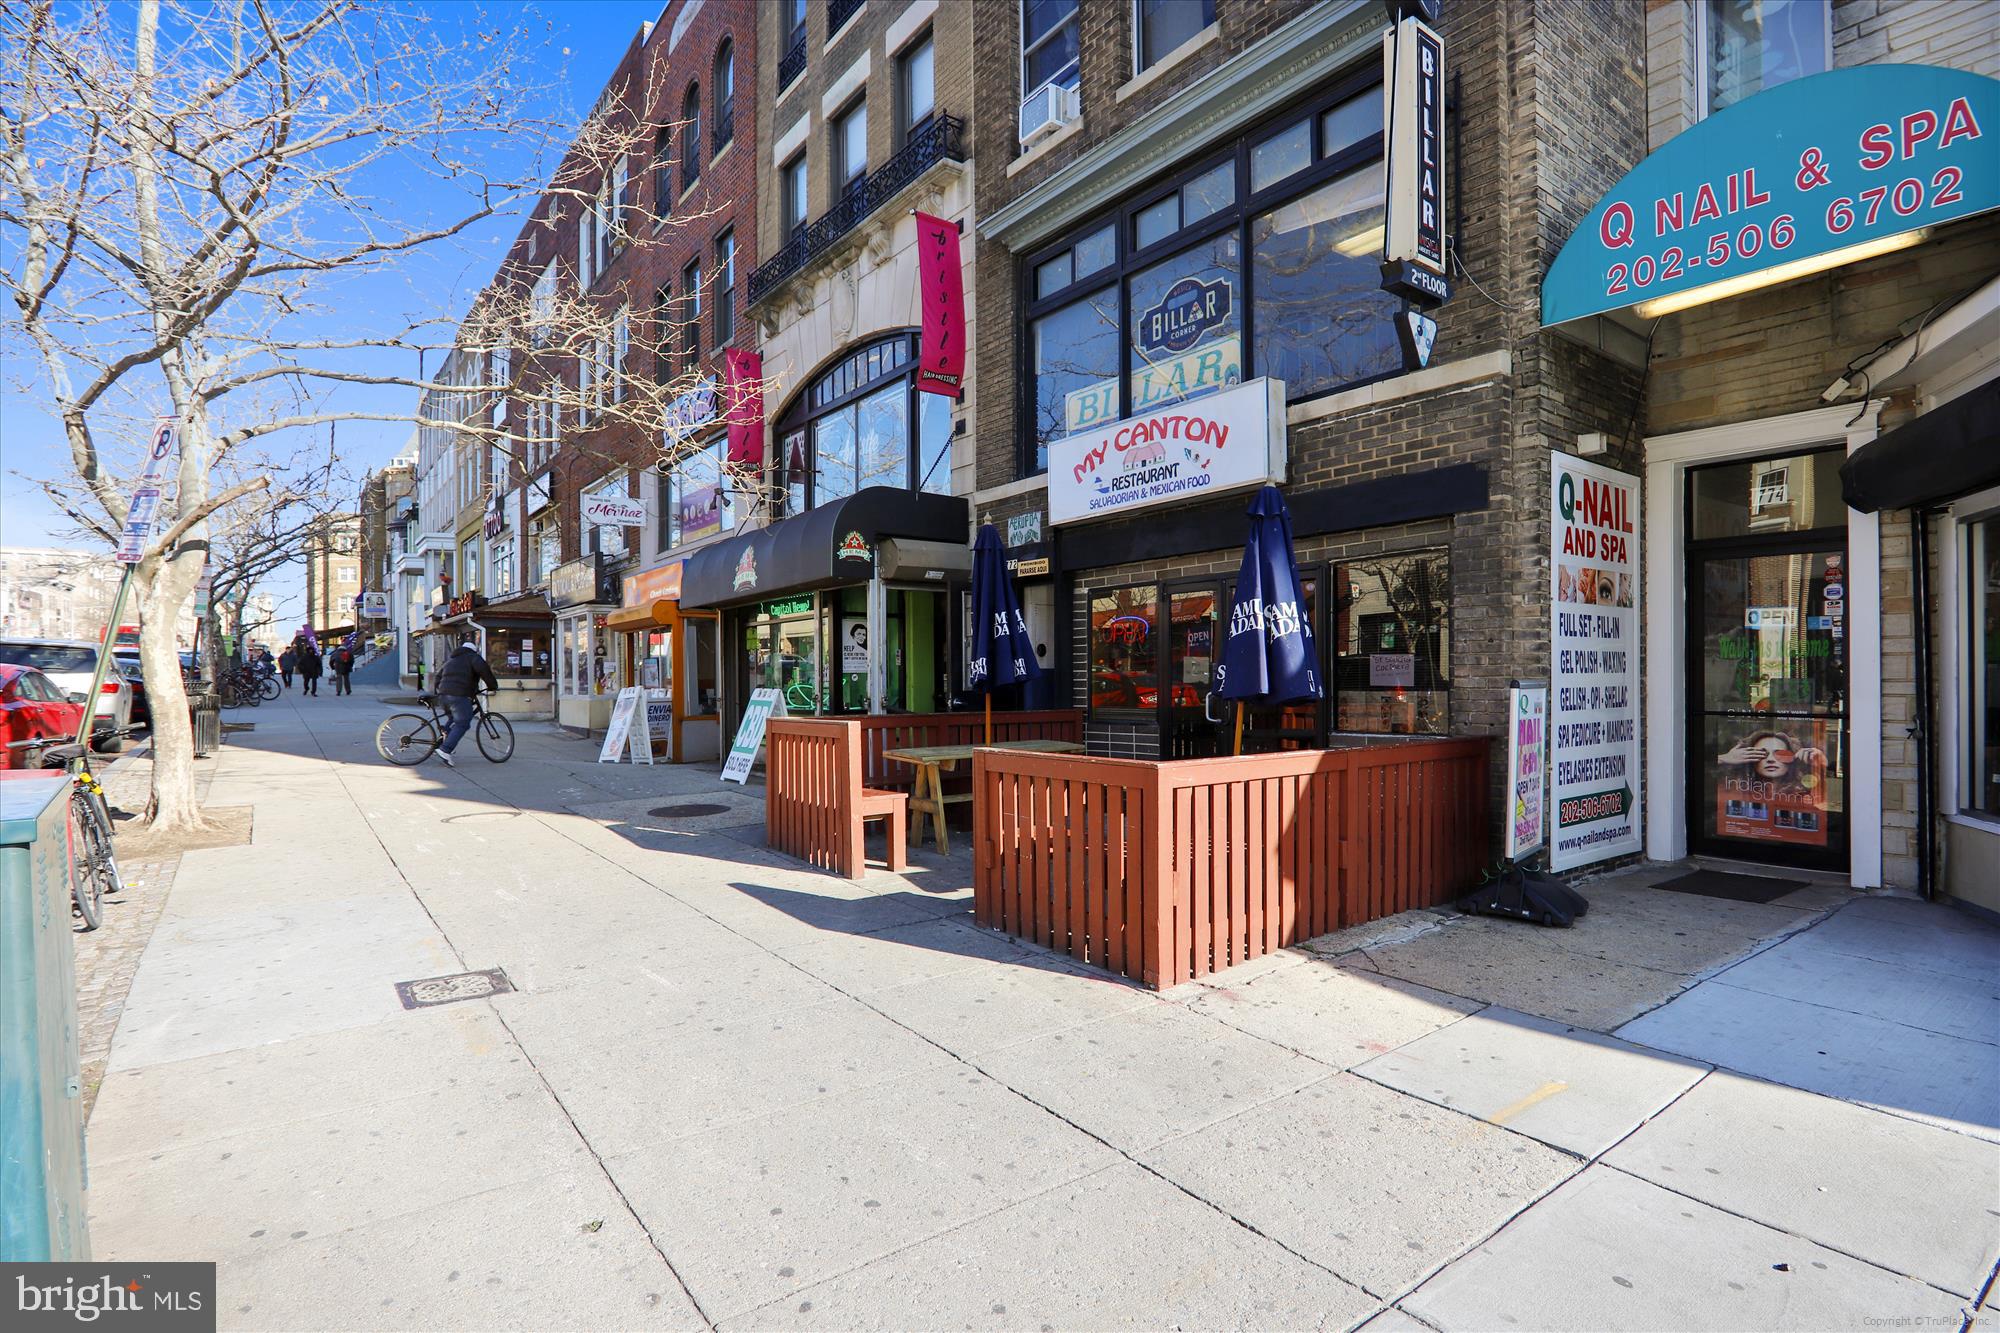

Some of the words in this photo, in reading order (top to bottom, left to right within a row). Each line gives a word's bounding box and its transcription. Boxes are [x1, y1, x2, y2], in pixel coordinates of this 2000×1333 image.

[1421, 45, 1435, 231] BILLAR
[1600, 201, 1635, 250] Q
[1654, 168, 1771, 236] NAIL
[1795, 147, 1831, 191] &
[1859, 97, 1982, 171] SPA
[1606, 214, 1796, 296] 202-506
[1826, 166, 1963, 235] 6702
[1422, 272, 1447, 298] FLOOR
[1152, 290, 1216, 341] BILLAR
[1170, 325, 1196, 339] CORNER
[1073, 440, 1108, 484] MY
[1114, 416, 1229, 452] CANTON
[1111, 462, 1180, 492] RESTAURANT
[1089, 491, 1139, 510] SALVADORIAN
[1140, 489, 1148, 499] &
[1150, 479, 1187, 497] MEXICAN
[1187, 474, 1211, 488] FOOD
[1559, 472, 1633, 534] Q-NAIL
[1760, 486, 1784, 503] 774
[1563, 526, 1597, 559] AND
[1600, 533, 1627, 564] SPA
[1188, 631, 1209, 642] OPEN
[1559, 612, 1578, 637] FULL
[1579, 614, 1592, 638] SET
[1597, 615, 1620, 639] FILL-IN
[1560, 650, 1573, 673] GEL
[1575, 650, 1598, 674] POLISH
[1602, 651, 1627, 674] WAXING
[1519, 694, 1528, 713] Q
[1560, 687, 1587, 712] GELLISH
[1590, 687, 1601, 709] OPI
[1604, 686, 1628, 708] SHELLAC
[648, 714, 671, 722] DINERO
[736, 704, 769, 748] CBD
[1518, 718, 1542, 746] NAIL
[1558, 725, 1570, 749] SPA
[1571, 721, 1600, 747] PEDICURE
[1606, 719, 1633, 744] MANICURE
[1558, 757, 1593, 786] EYELASHES
[1594, 754, 1626, 781] EXTENSION
[1725, 775, 1774, 792] Indian
[1517, 780, 1528, 796] OPEN
[1560, 792, 1621, 823] 202-506-6702
[1558, 824, 1631, 851] www.q-nailandspa.com
